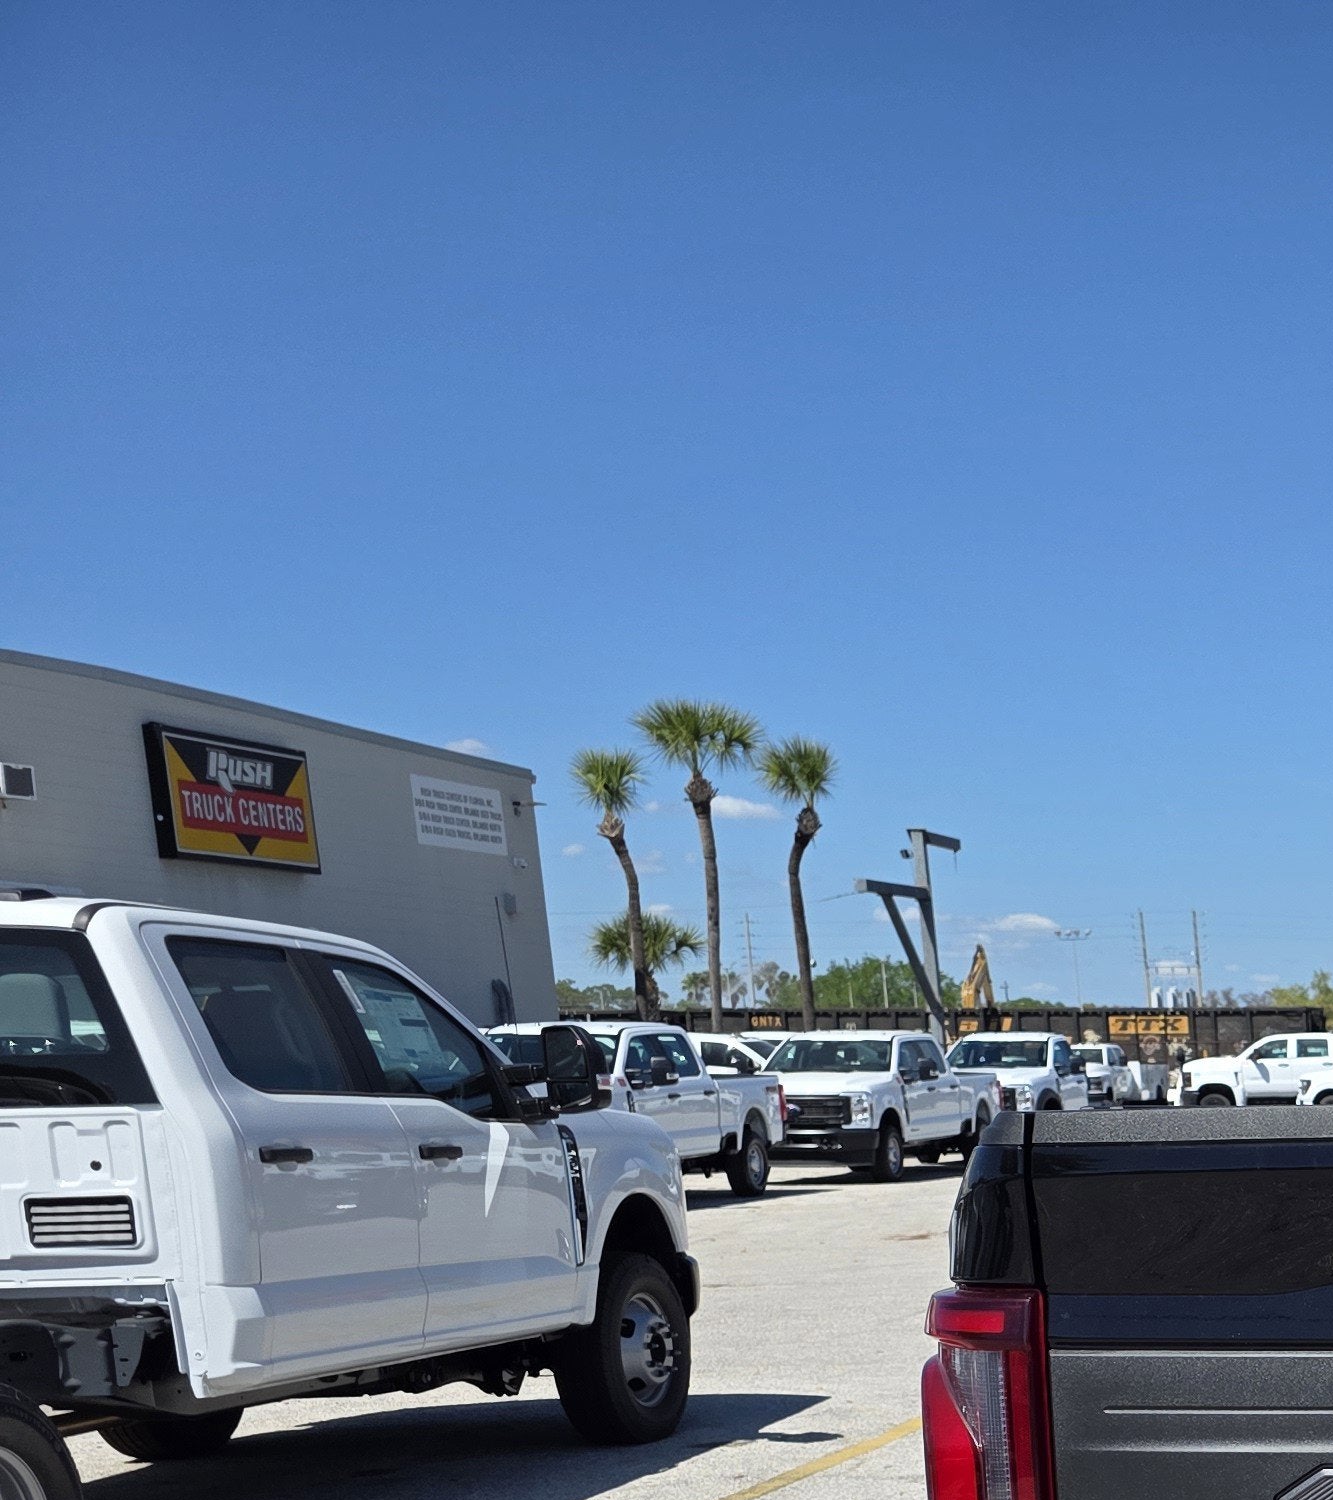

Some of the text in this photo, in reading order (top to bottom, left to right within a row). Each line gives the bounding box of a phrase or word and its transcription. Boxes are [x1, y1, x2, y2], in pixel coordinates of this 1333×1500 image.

[206, 749, 273, 793] RUSH
[182, 790, 304, 832] TRUCK CENTERS
[1114, 1018, 1182, 1032] TTX
